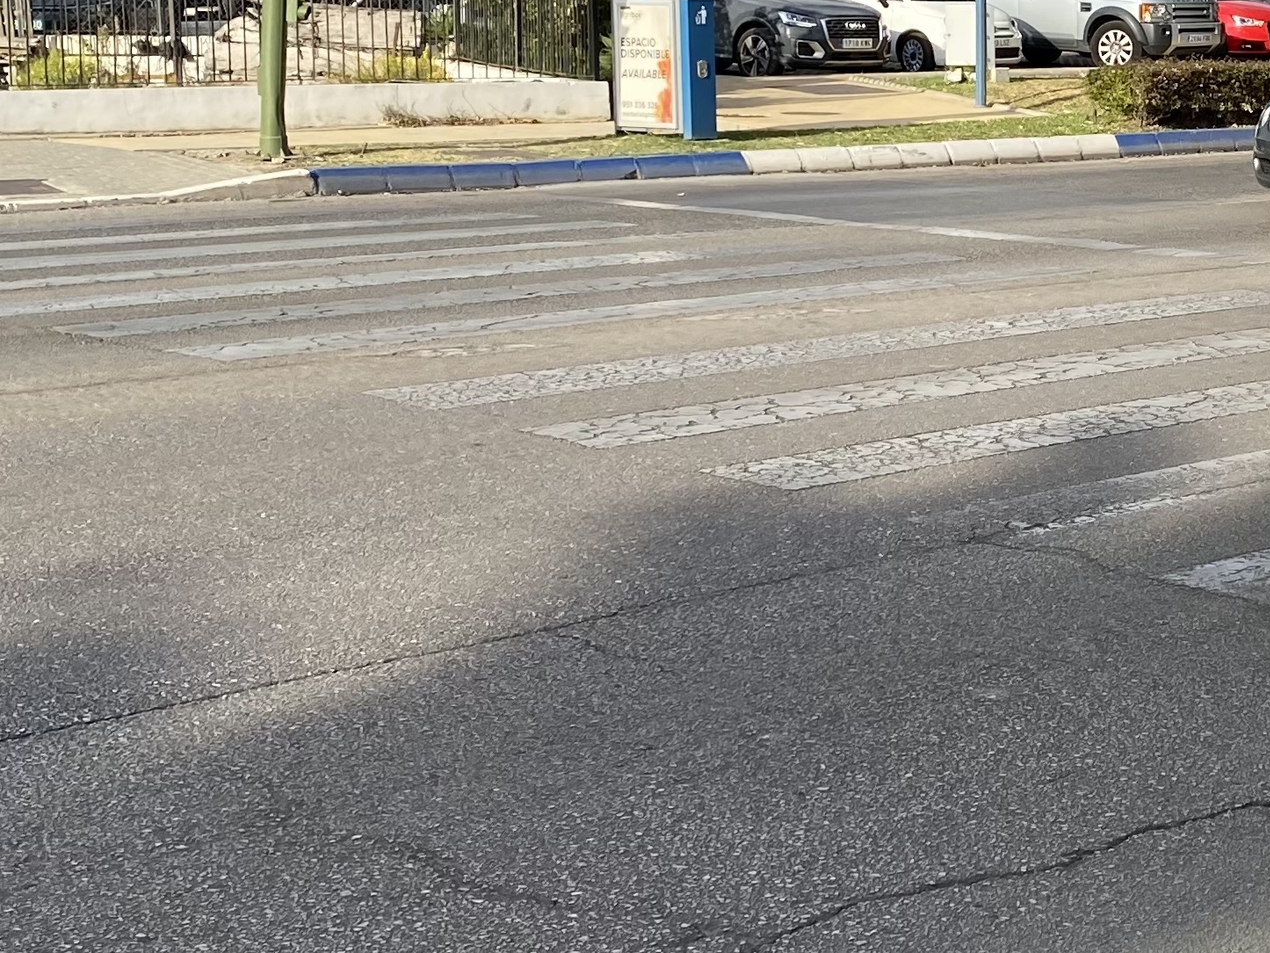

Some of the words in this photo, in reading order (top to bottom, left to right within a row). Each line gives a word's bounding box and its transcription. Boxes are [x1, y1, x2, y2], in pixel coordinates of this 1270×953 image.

[620, 37, 656, 47] ESPACIO
[620, 48, 670, 59] DISPONIBLE
[622, 68, 667, 79] AVAILABLE
